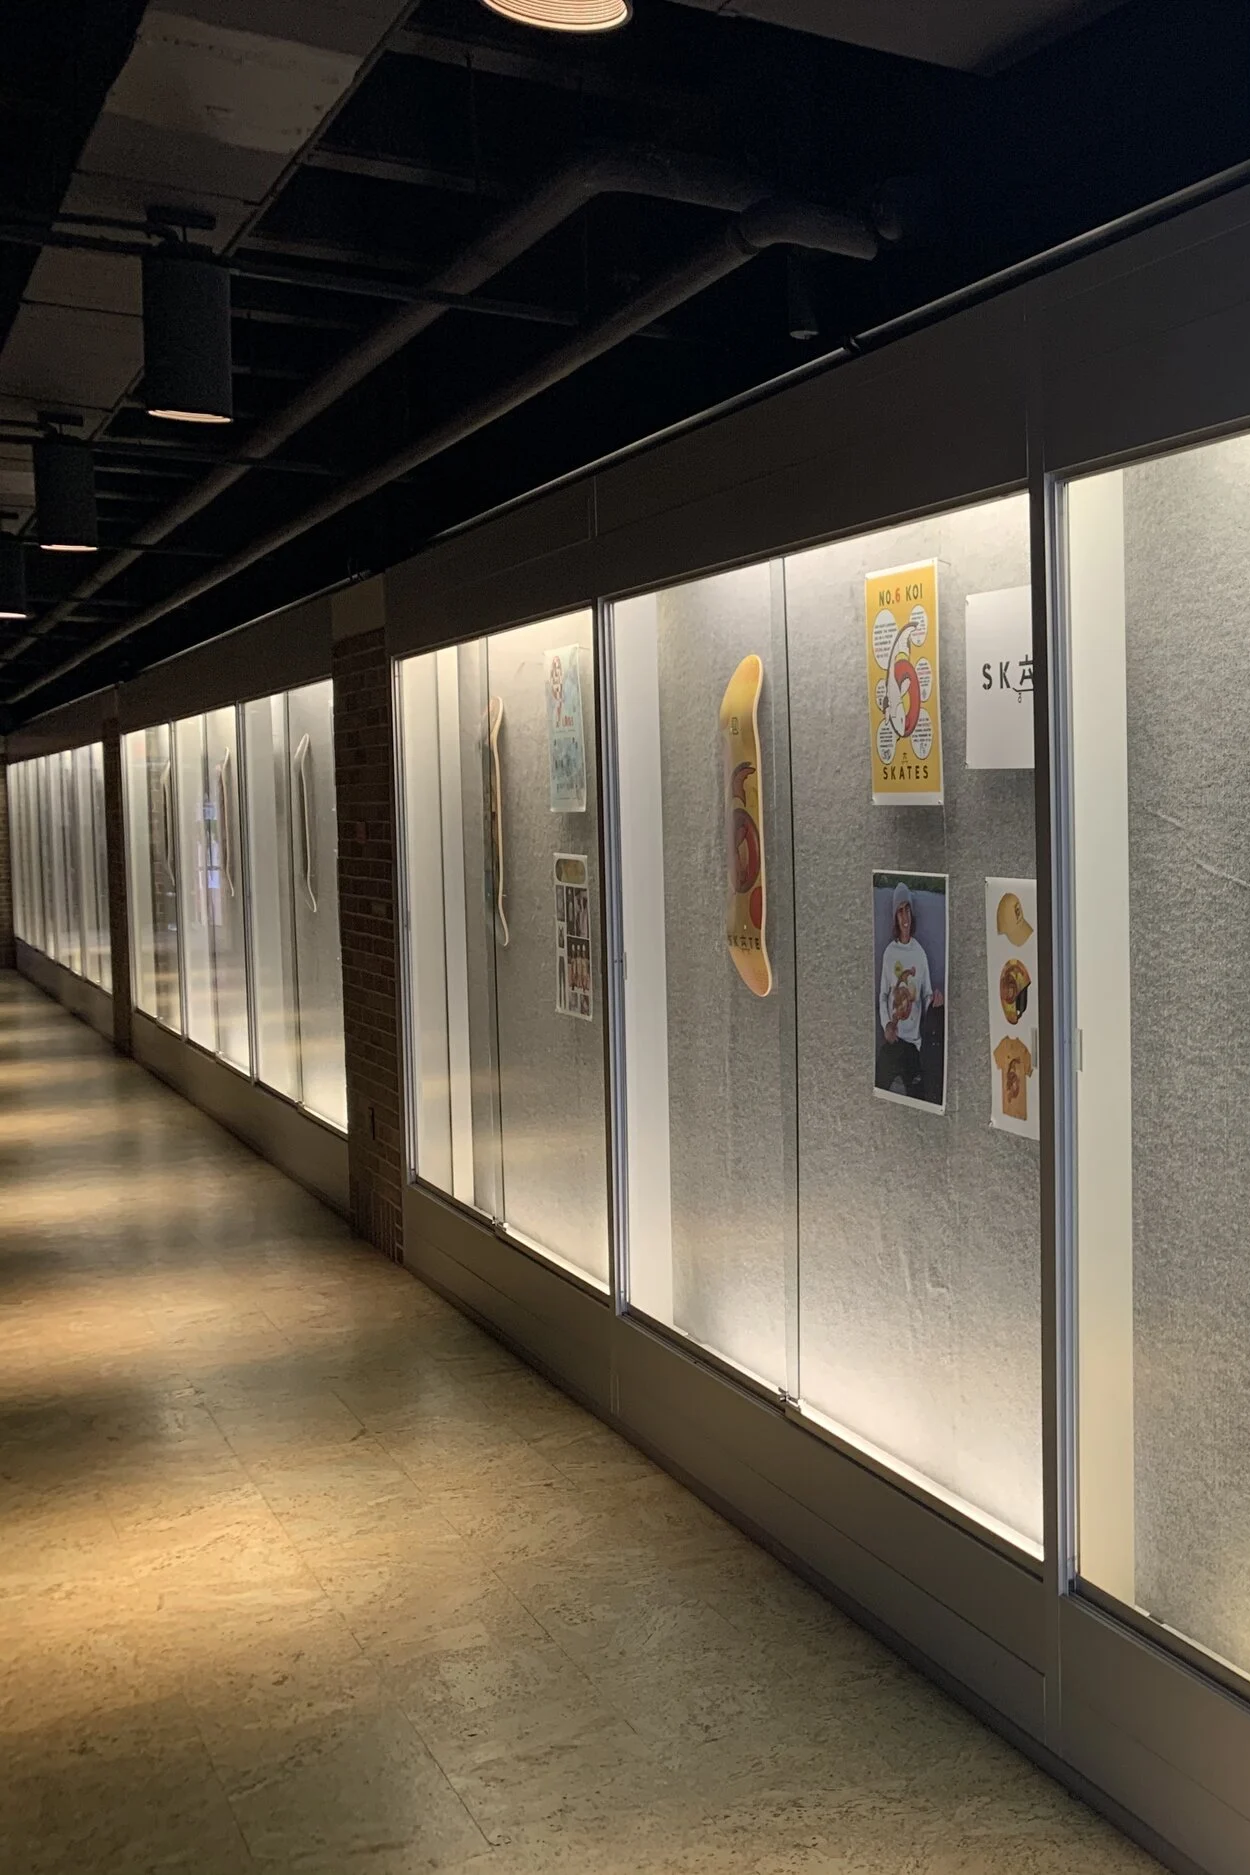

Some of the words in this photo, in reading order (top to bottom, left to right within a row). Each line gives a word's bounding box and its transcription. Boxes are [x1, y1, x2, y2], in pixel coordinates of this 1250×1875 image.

[878, 587, 900, 606] NO.6
[906, 582, 922, 602] KOI
[882, 765, 928, 780] SKATES
